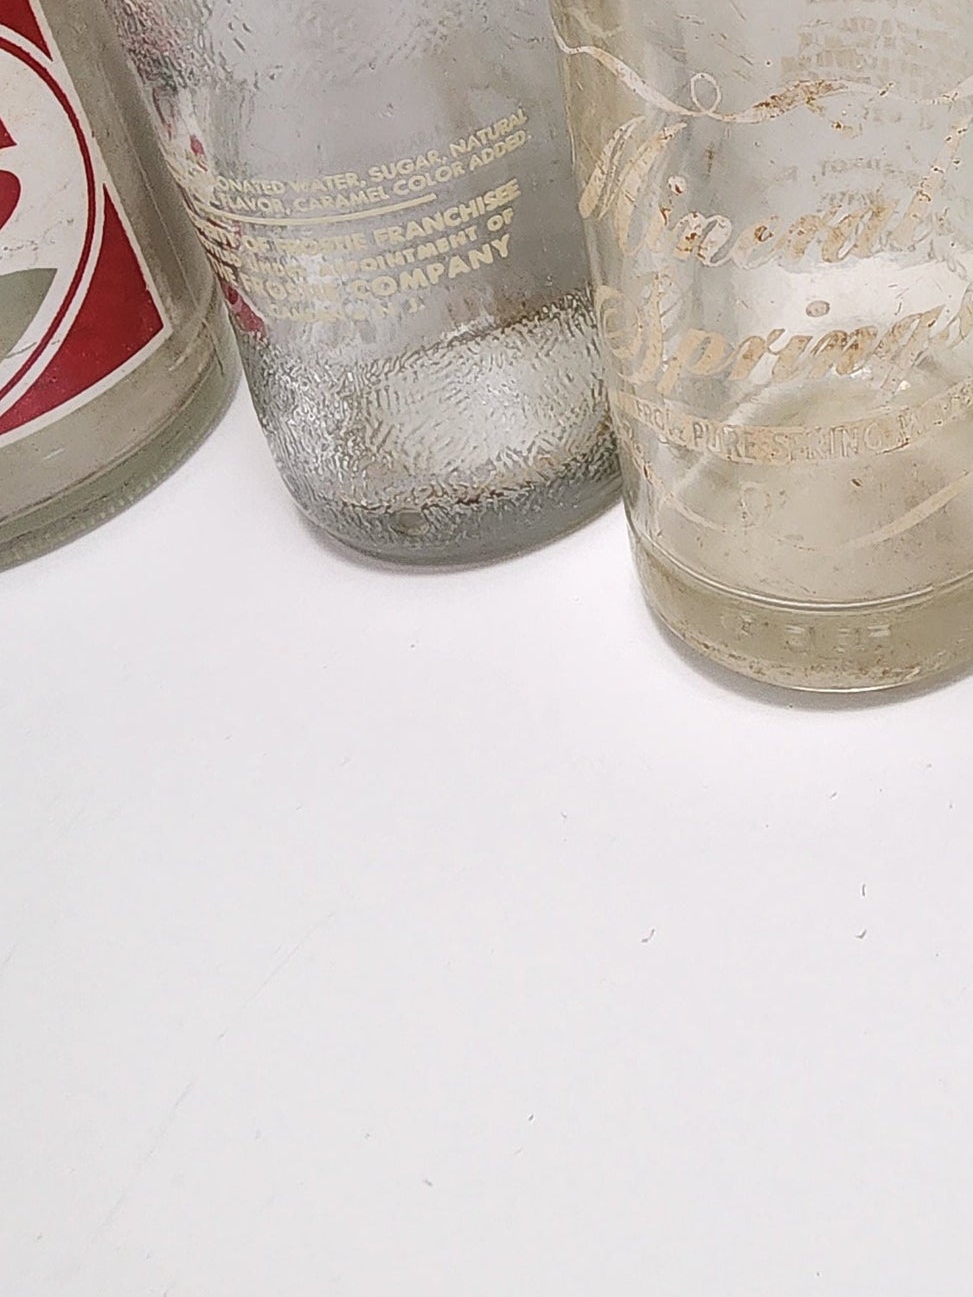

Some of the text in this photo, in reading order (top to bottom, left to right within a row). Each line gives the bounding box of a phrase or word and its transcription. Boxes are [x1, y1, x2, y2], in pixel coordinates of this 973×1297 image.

[289, 171, 366, 194] WATER,
[368, 149, 448, 183] SUGAR,
[450, 108, 529, 158] NATURAL
[392, 162, 466, 196] COLOR
[373, 178, 522, 247] FRANCHISEE
[487, 207, 515, 233] OF
[351, 233, 511, 301] COMPANY
